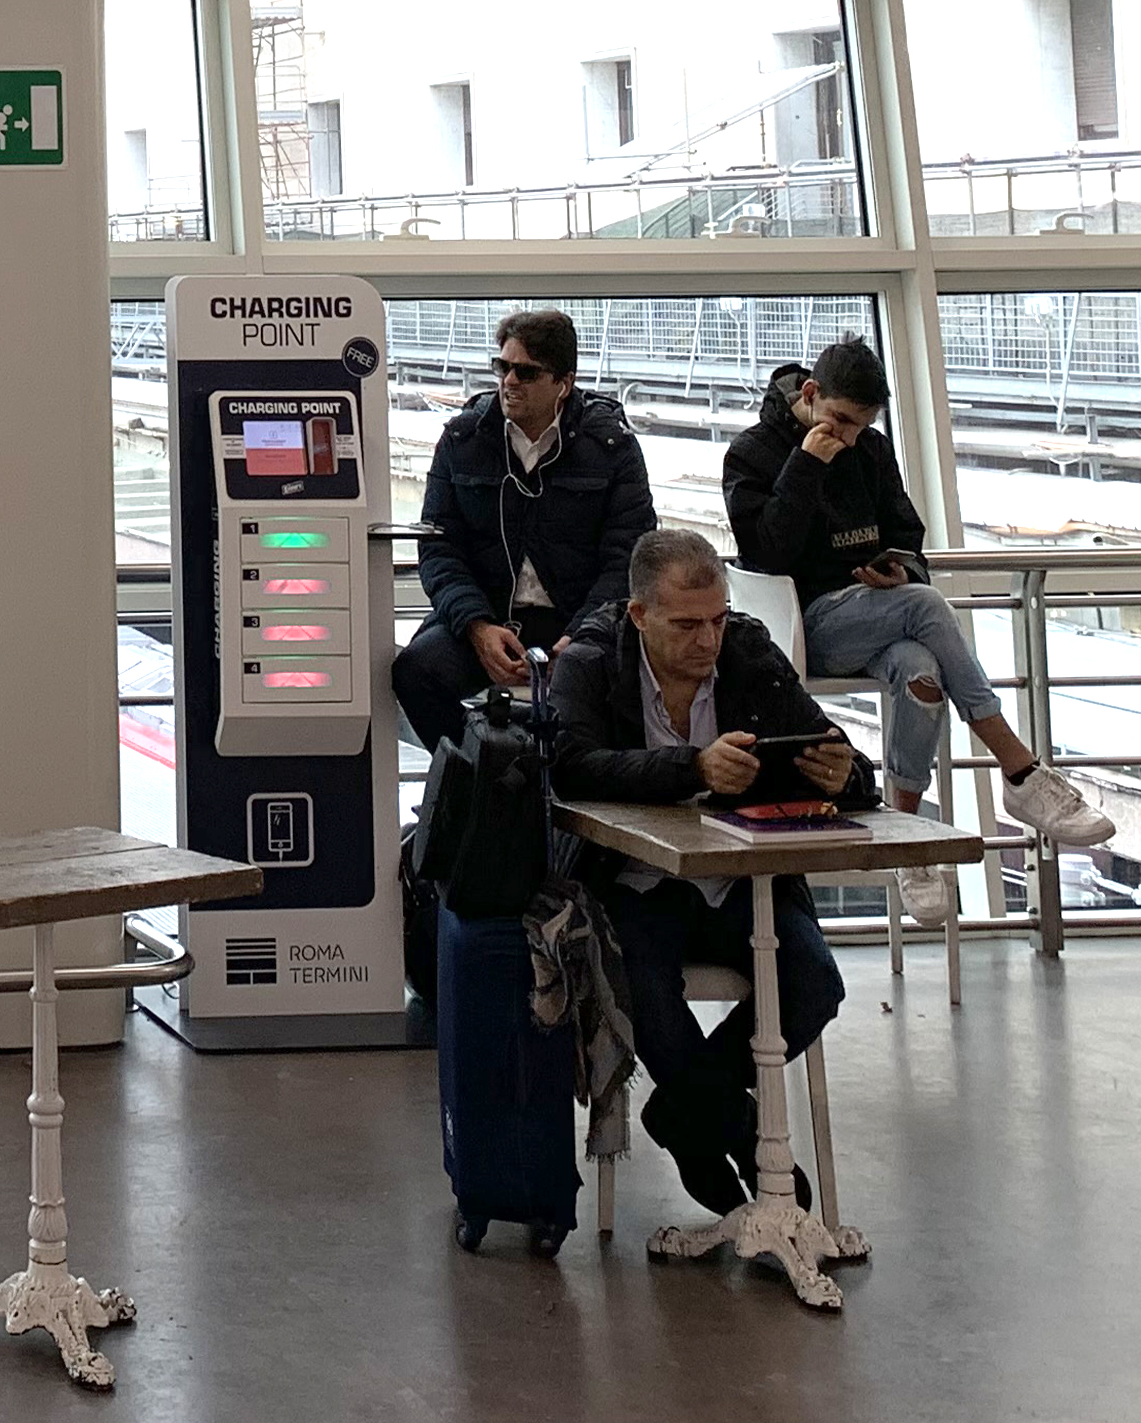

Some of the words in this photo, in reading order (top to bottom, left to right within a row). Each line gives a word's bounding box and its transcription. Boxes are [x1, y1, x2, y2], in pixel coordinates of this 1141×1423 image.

[210, 296, 352, 319] CHARGING
[242, 322, 321, 347] POINT
[345, 346, 375, 369] FREE
[228, 402, 298, 415] CHARGING
[301, 402, 341, 414] POINT
[249, 524, 257, 534] 1
[249, 570, 258, 580] 2
[251, 617, 259, 627] 3
[250, 663, 259, 674] 4
[289, 944, 345, 962] ROMA
[289, 966, 369, 984] TERMINI
